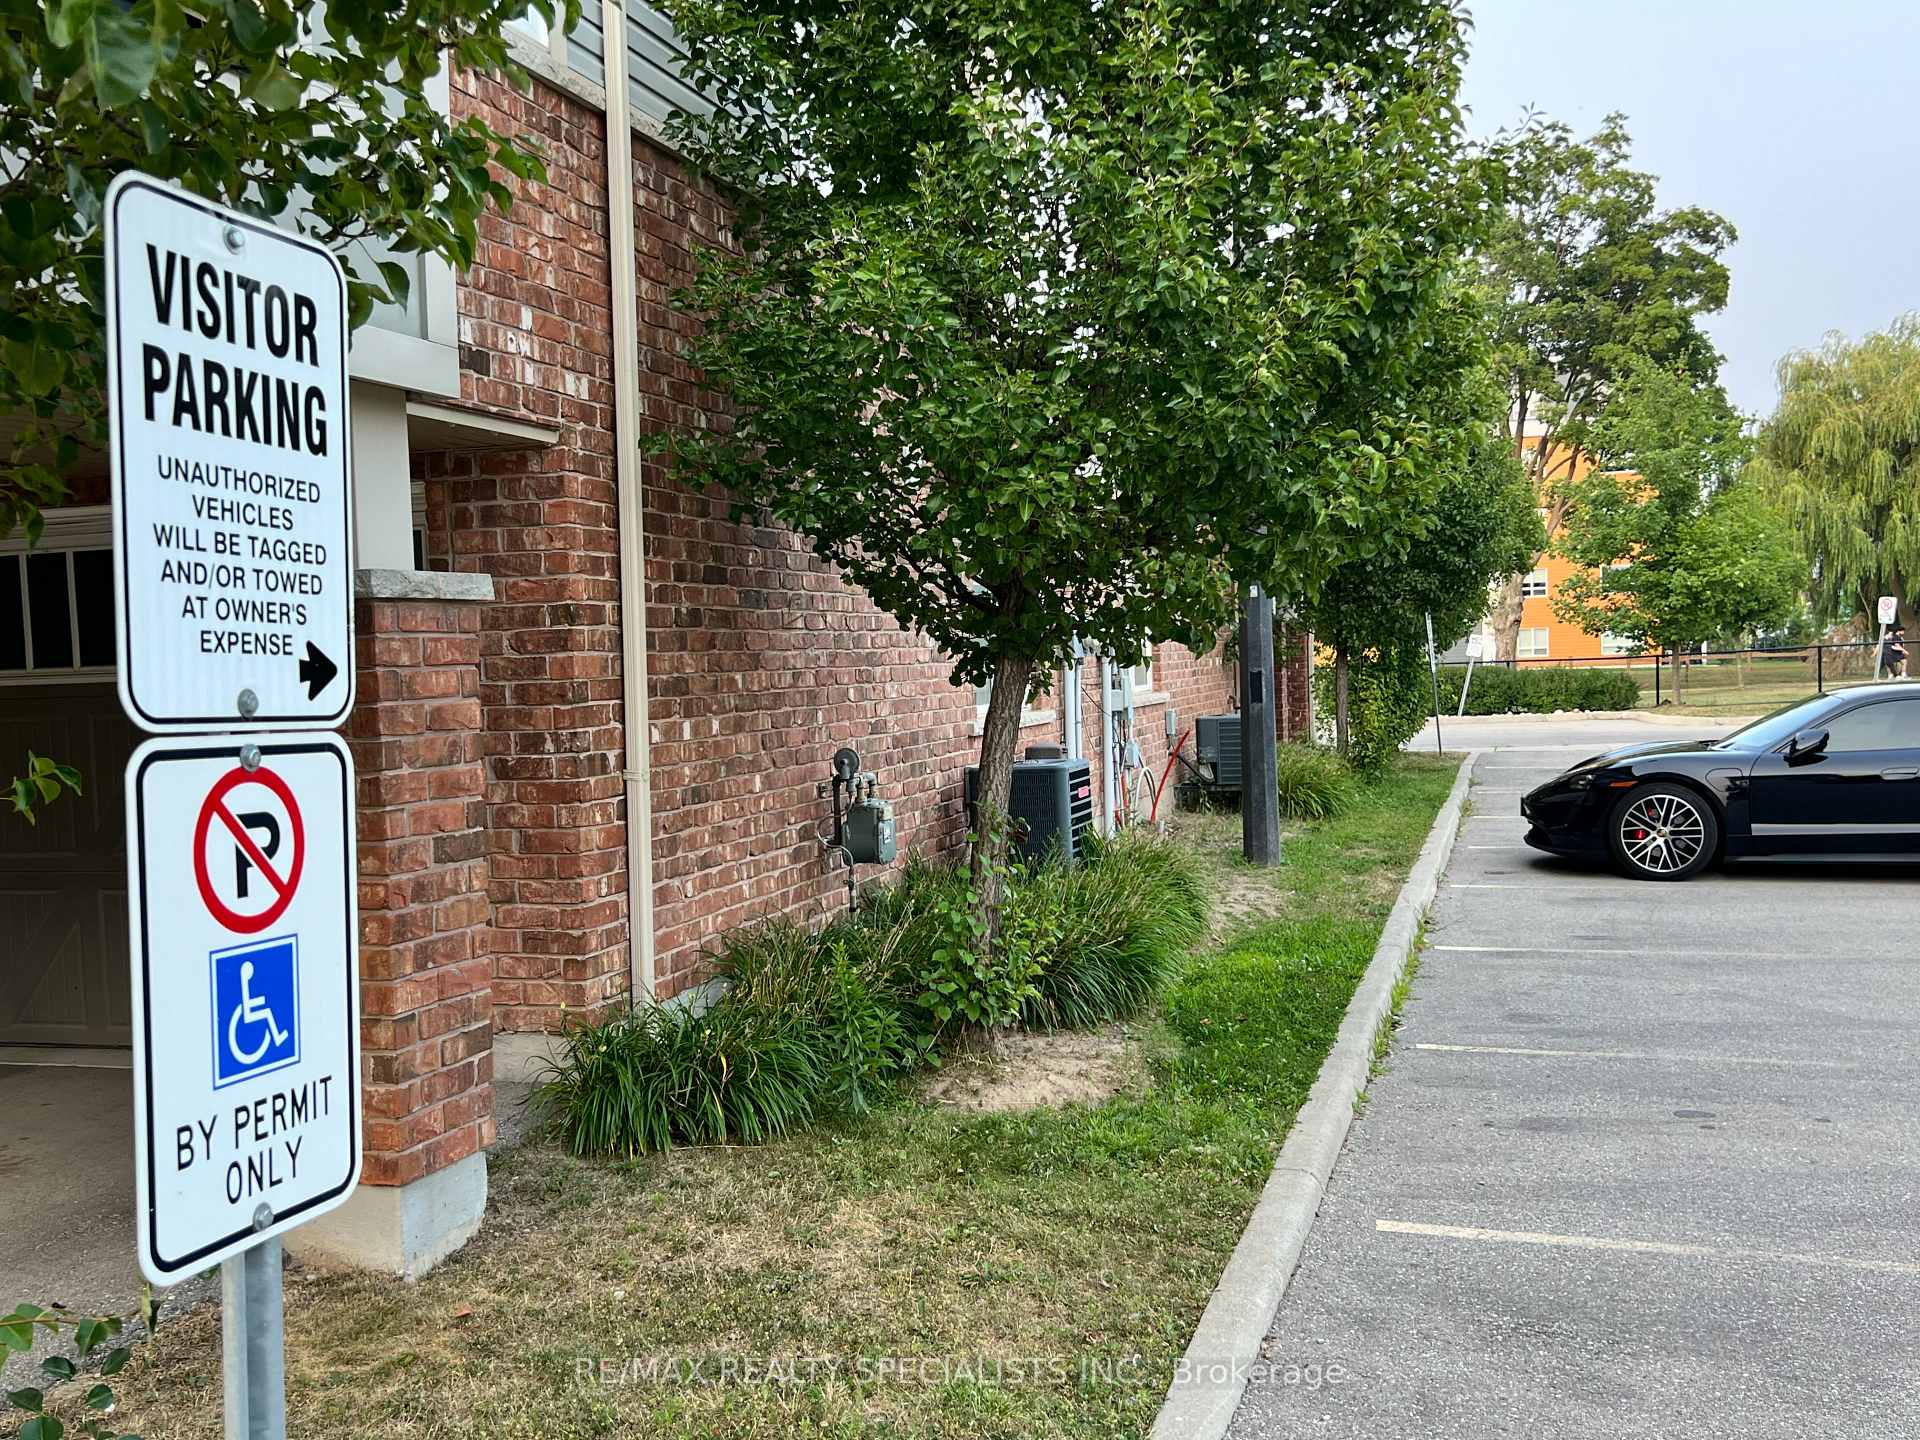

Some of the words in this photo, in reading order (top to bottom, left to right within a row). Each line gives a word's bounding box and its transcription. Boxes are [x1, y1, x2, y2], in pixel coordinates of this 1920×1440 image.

[146, 242, 320, 368] VISITOR
[142, 342, 328, 457] PARKING
[157, 454, 321, 503] UNAUTHORIZED
[192, 494, 294, 530] VEHICLES
[153, 522, 207, 552] WILL
[214, 531, 241, 556] BE
[247, 535, 327, 565] TAGGED
[160, 559, 246, 589] AND/OR
[252, 568, 323, 596] TOWED
[181, 595, 208, 619] AT
[215, 597, 307, 625] OWNER'S
[200, 630, 293, 655] EXPENSE
[234, 810, 281, 899] P
[176, 1113, 218, 1171] BY
[234, 1074, 332, 1150] PERMIT
[226, 1135, 303, 1204] ONLY
